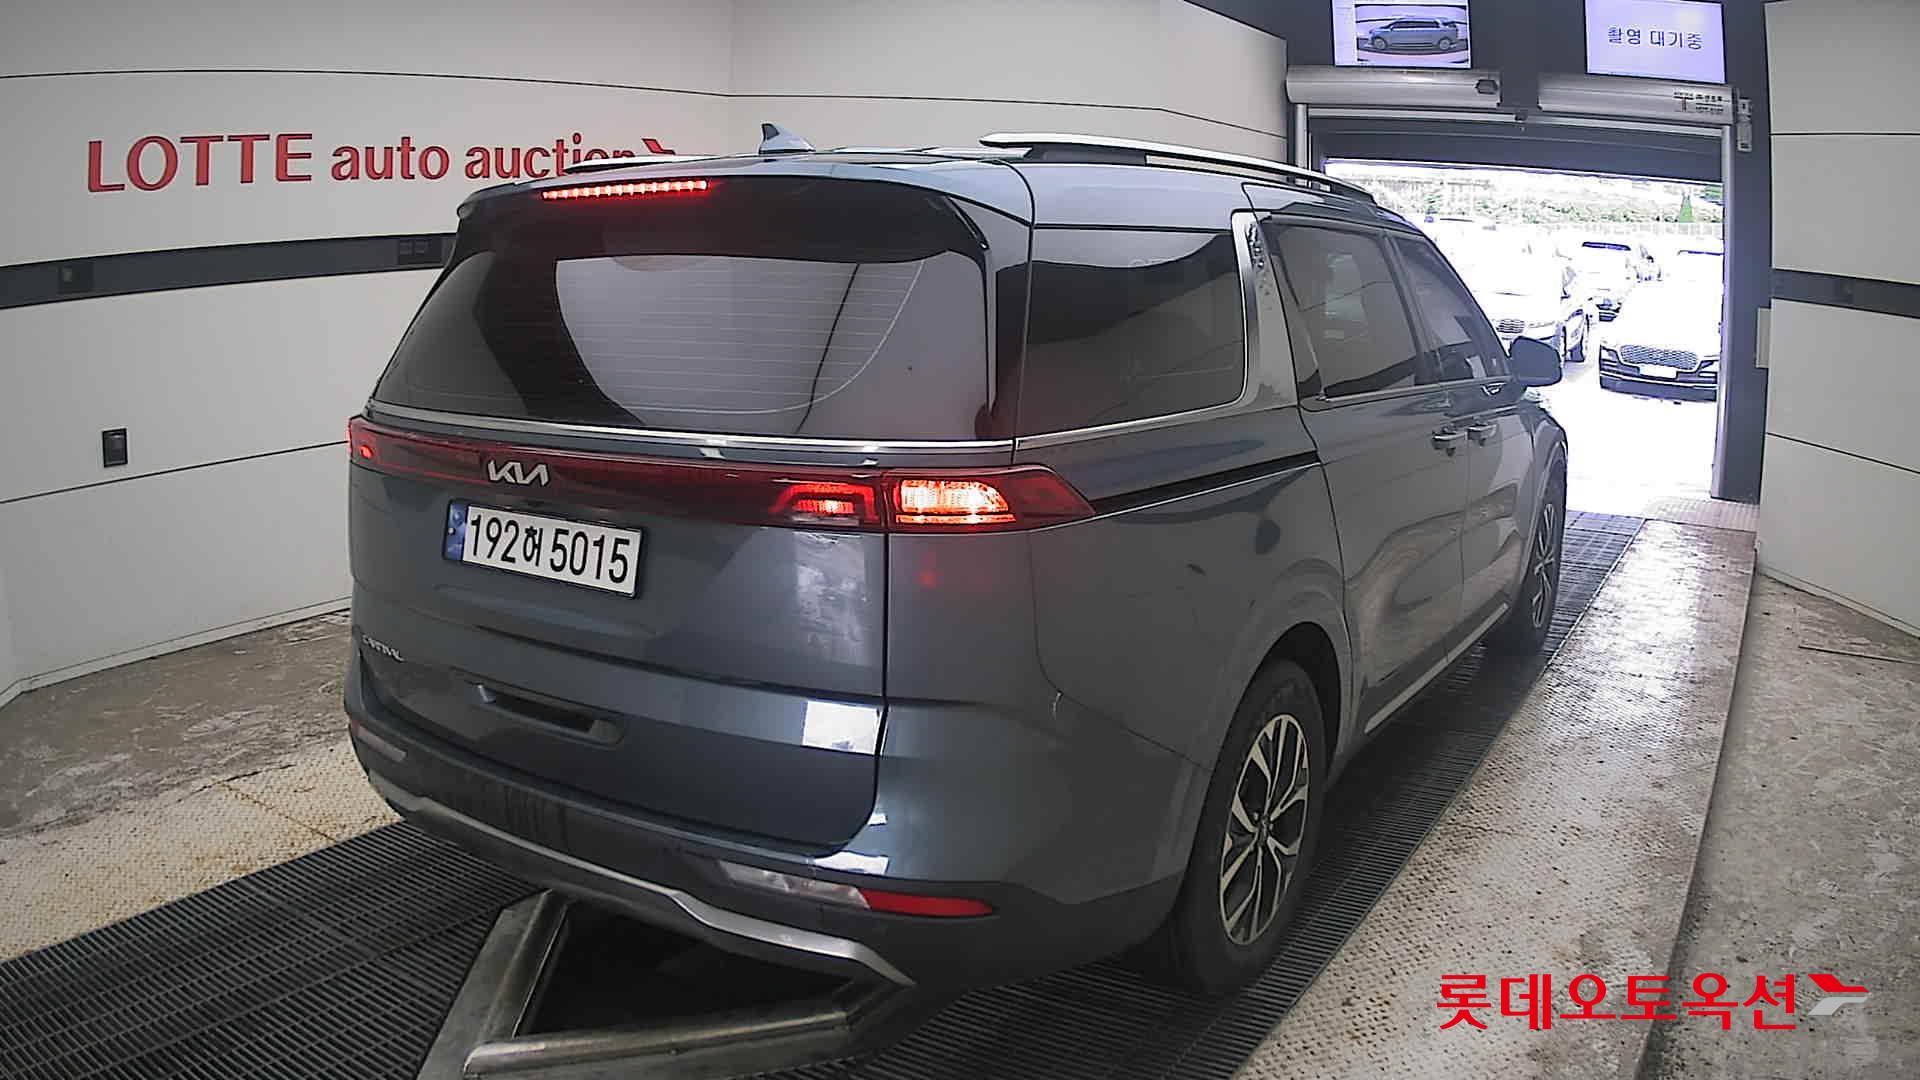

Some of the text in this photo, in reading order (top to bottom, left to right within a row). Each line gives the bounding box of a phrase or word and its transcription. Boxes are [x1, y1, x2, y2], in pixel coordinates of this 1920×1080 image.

[1608, 27, 1703, 50] 촬영 대기중
[87, 132, 635, 192] LOTTE auto aucti
[488, 459, 550, 486] KIA
